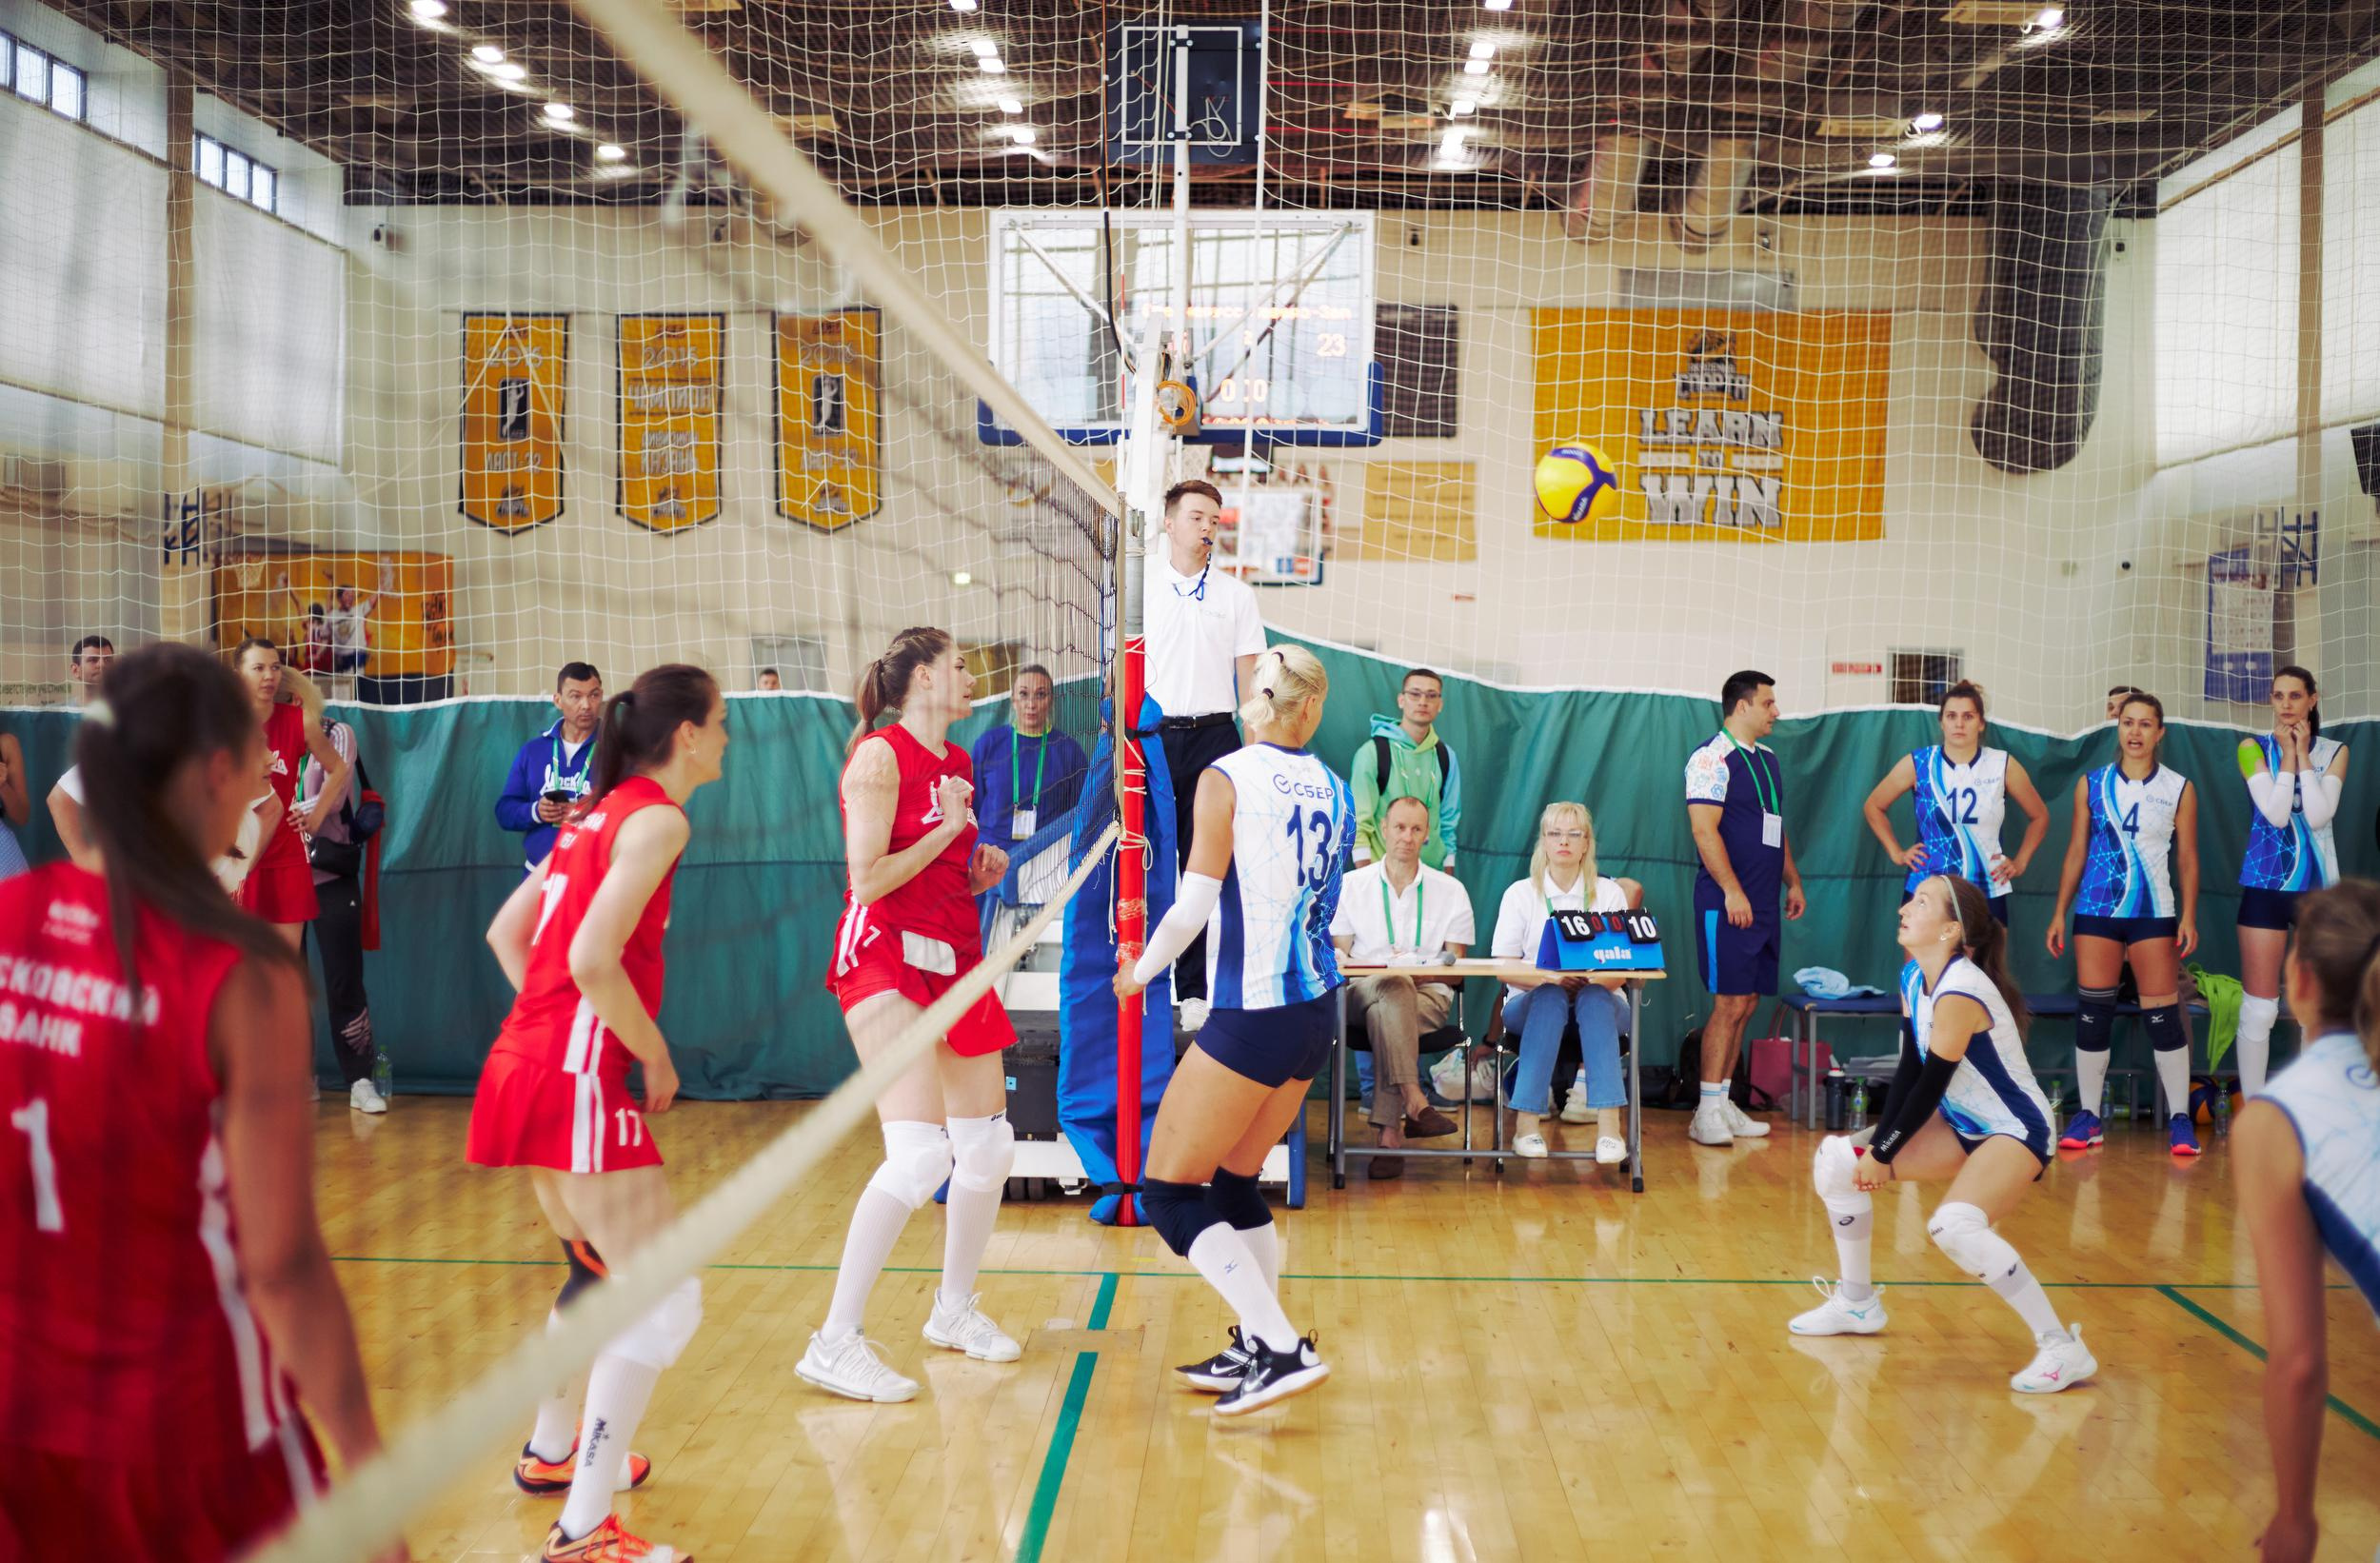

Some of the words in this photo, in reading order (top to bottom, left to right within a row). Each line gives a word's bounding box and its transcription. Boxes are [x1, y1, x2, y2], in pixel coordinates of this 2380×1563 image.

[1638, 409, 1784, 446] LEARN
[1638, 472, 1783, 528] WIN
[1295, 782, 1333, 801] СБЕР
[1946, 787, 1978, 824] 12
[2122, 802, 2140, 841] 4
[1287, 804, 1333, 892] 13
[1561, 915, 1591, 936] 16
[1591, 915, 1602, 931] 0
[1629, 915, 1657, 939] 10
[1593, 946, 1632, 964] gala
[615, 1107, 641, 1147] 17
[11, 1097, 66, 1233] 1
